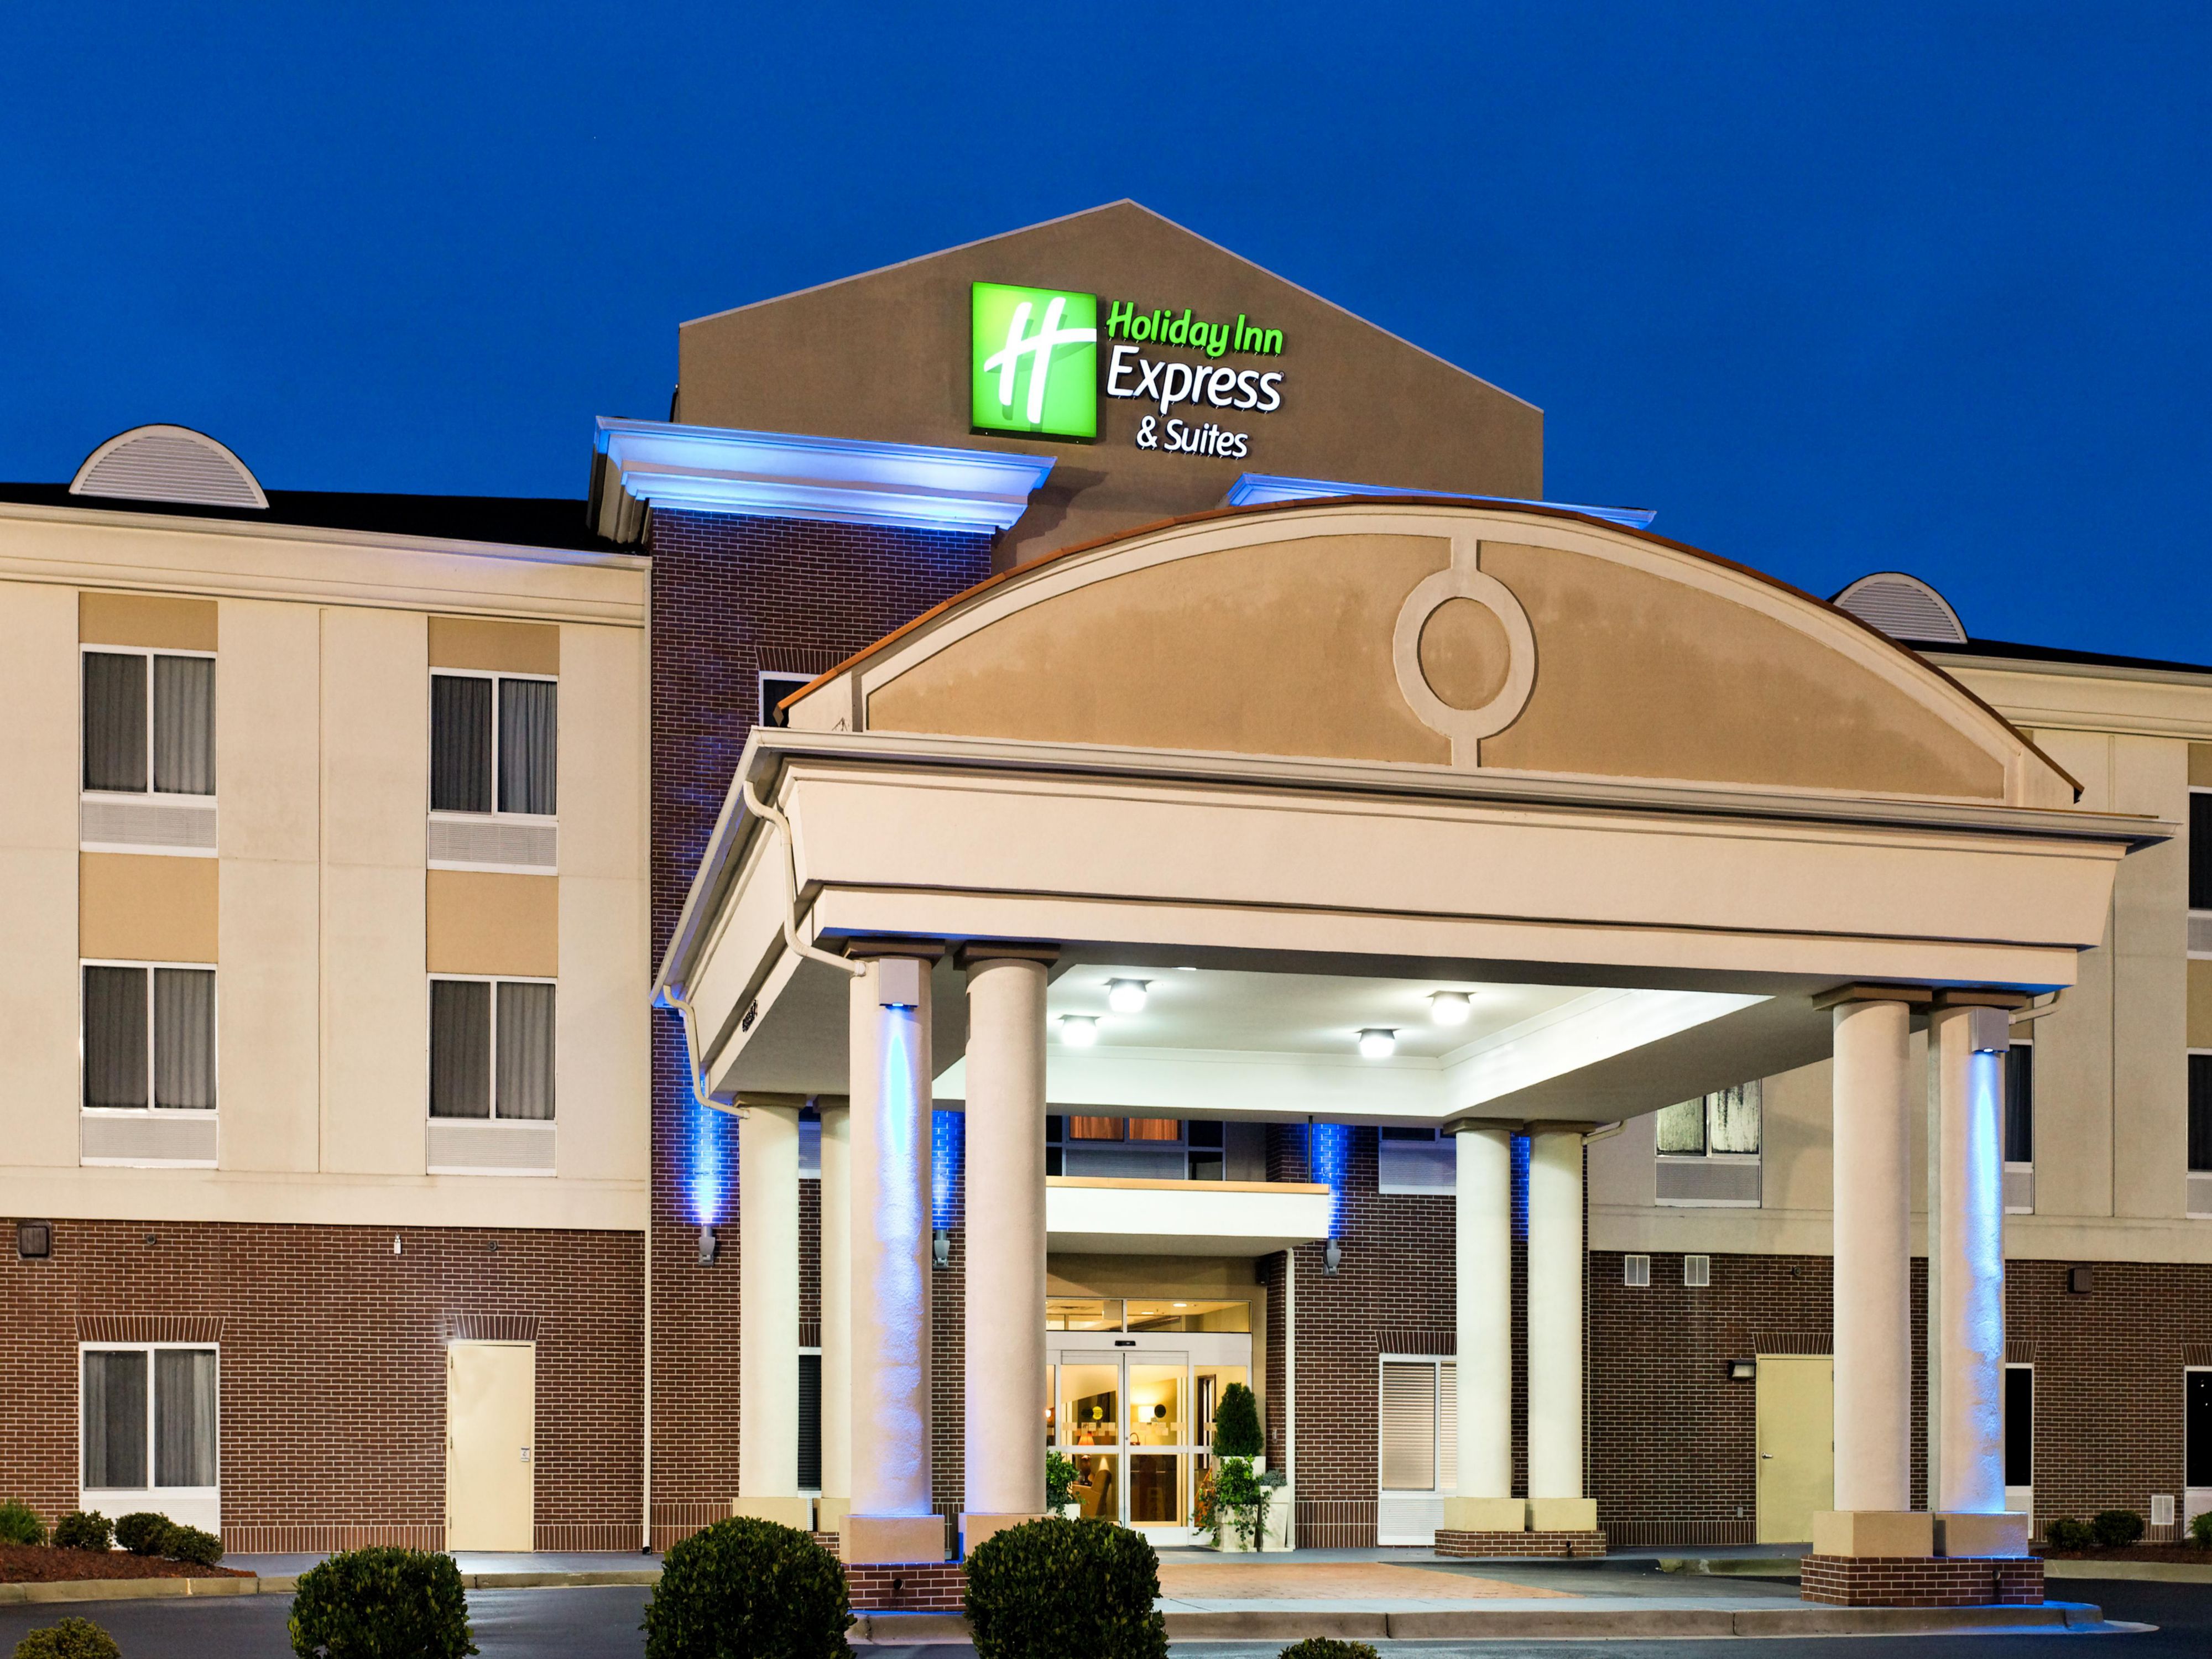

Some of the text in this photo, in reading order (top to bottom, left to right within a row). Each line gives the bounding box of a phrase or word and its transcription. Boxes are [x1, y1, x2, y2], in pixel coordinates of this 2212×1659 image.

[1106, 300, 1283, 357] Holiday Inn
[1107, 345, 1282, 415] Express
[1136, 415, 1248, 457] & Suites
